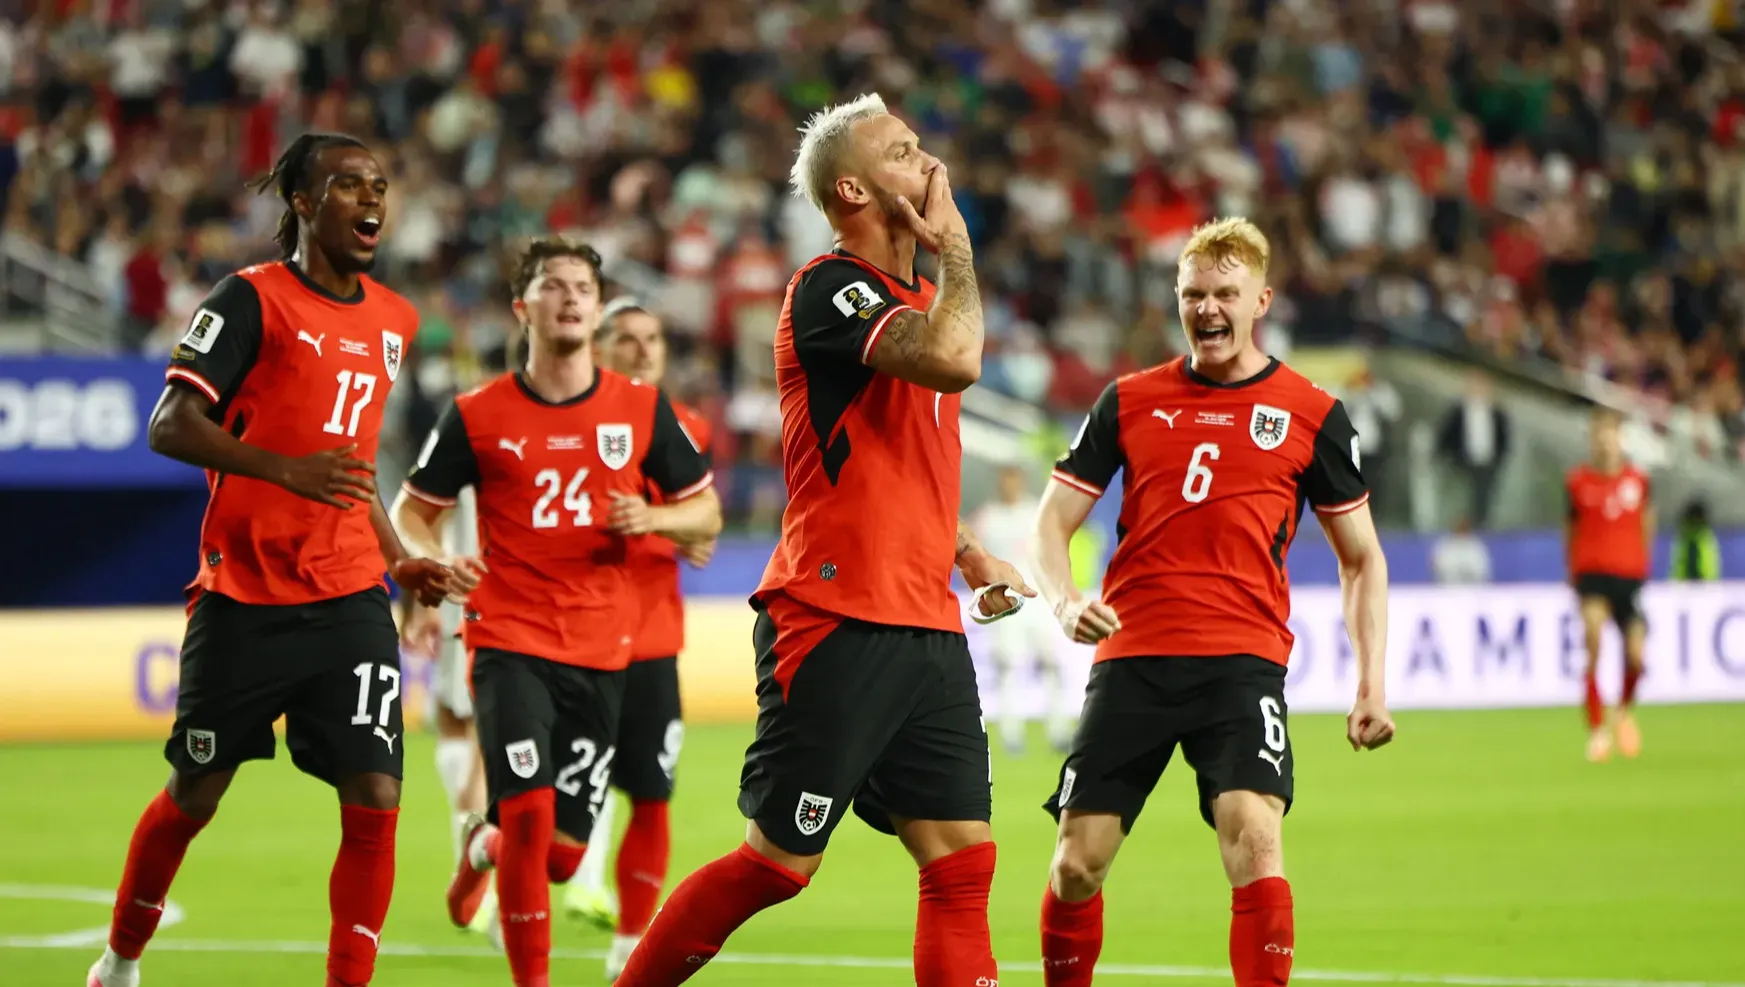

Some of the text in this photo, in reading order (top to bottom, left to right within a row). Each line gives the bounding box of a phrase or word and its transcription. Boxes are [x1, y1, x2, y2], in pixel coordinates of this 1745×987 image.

[323, 369, 377, 438] 17
[532, 466, 593, 528] 24
[1181, 442, 1221, 504] 6
[351, 661, 401, 728] 17
[1259, 695, 1285, 752] 6
[554, 737, 616, 804] 24
